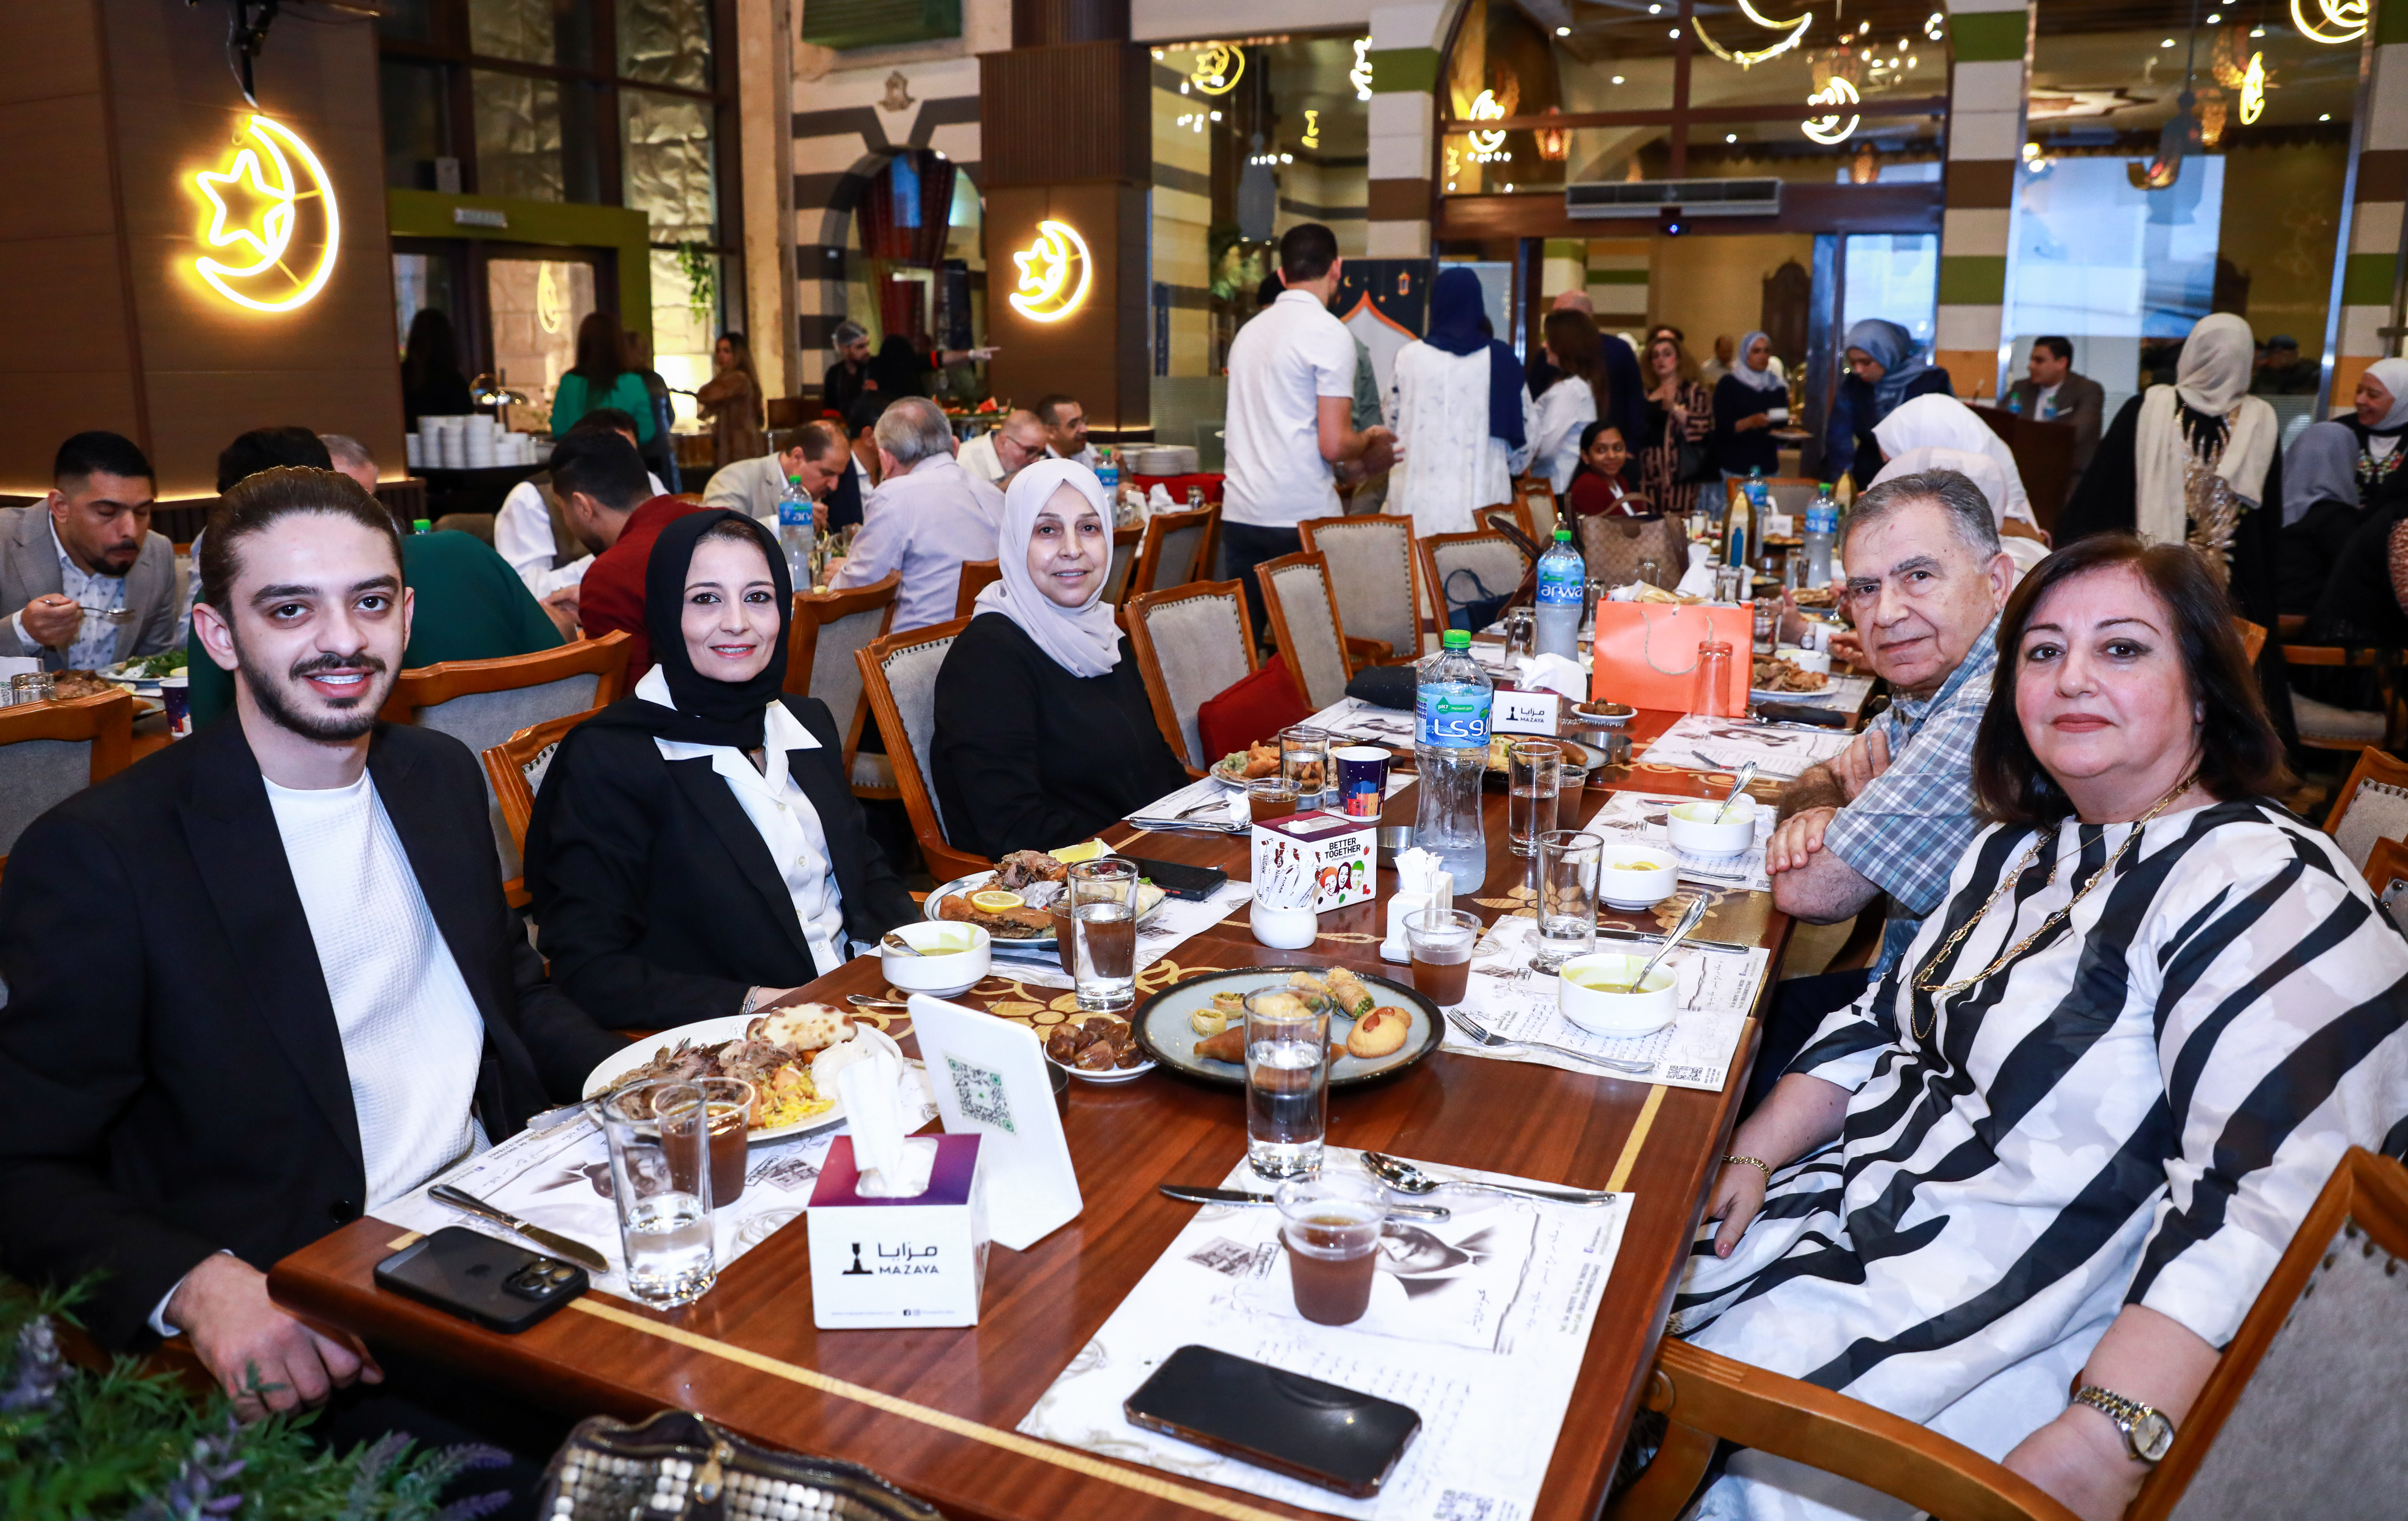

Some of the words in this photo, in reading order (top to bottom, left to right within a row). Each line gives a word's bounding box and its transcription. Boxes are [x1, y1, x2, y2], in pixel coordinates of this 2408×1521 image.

[1541, 585, 1583, 598] arwa
[1521, 707, 1544, 716] مزايا
[1329, 837, 1356, 850] BETTER
[1325, 845, 1361, 858] TOGETHER
[878, 1242, 937, 1261] مزايا
[880, 1264, 940, 1274] MAZAYA
